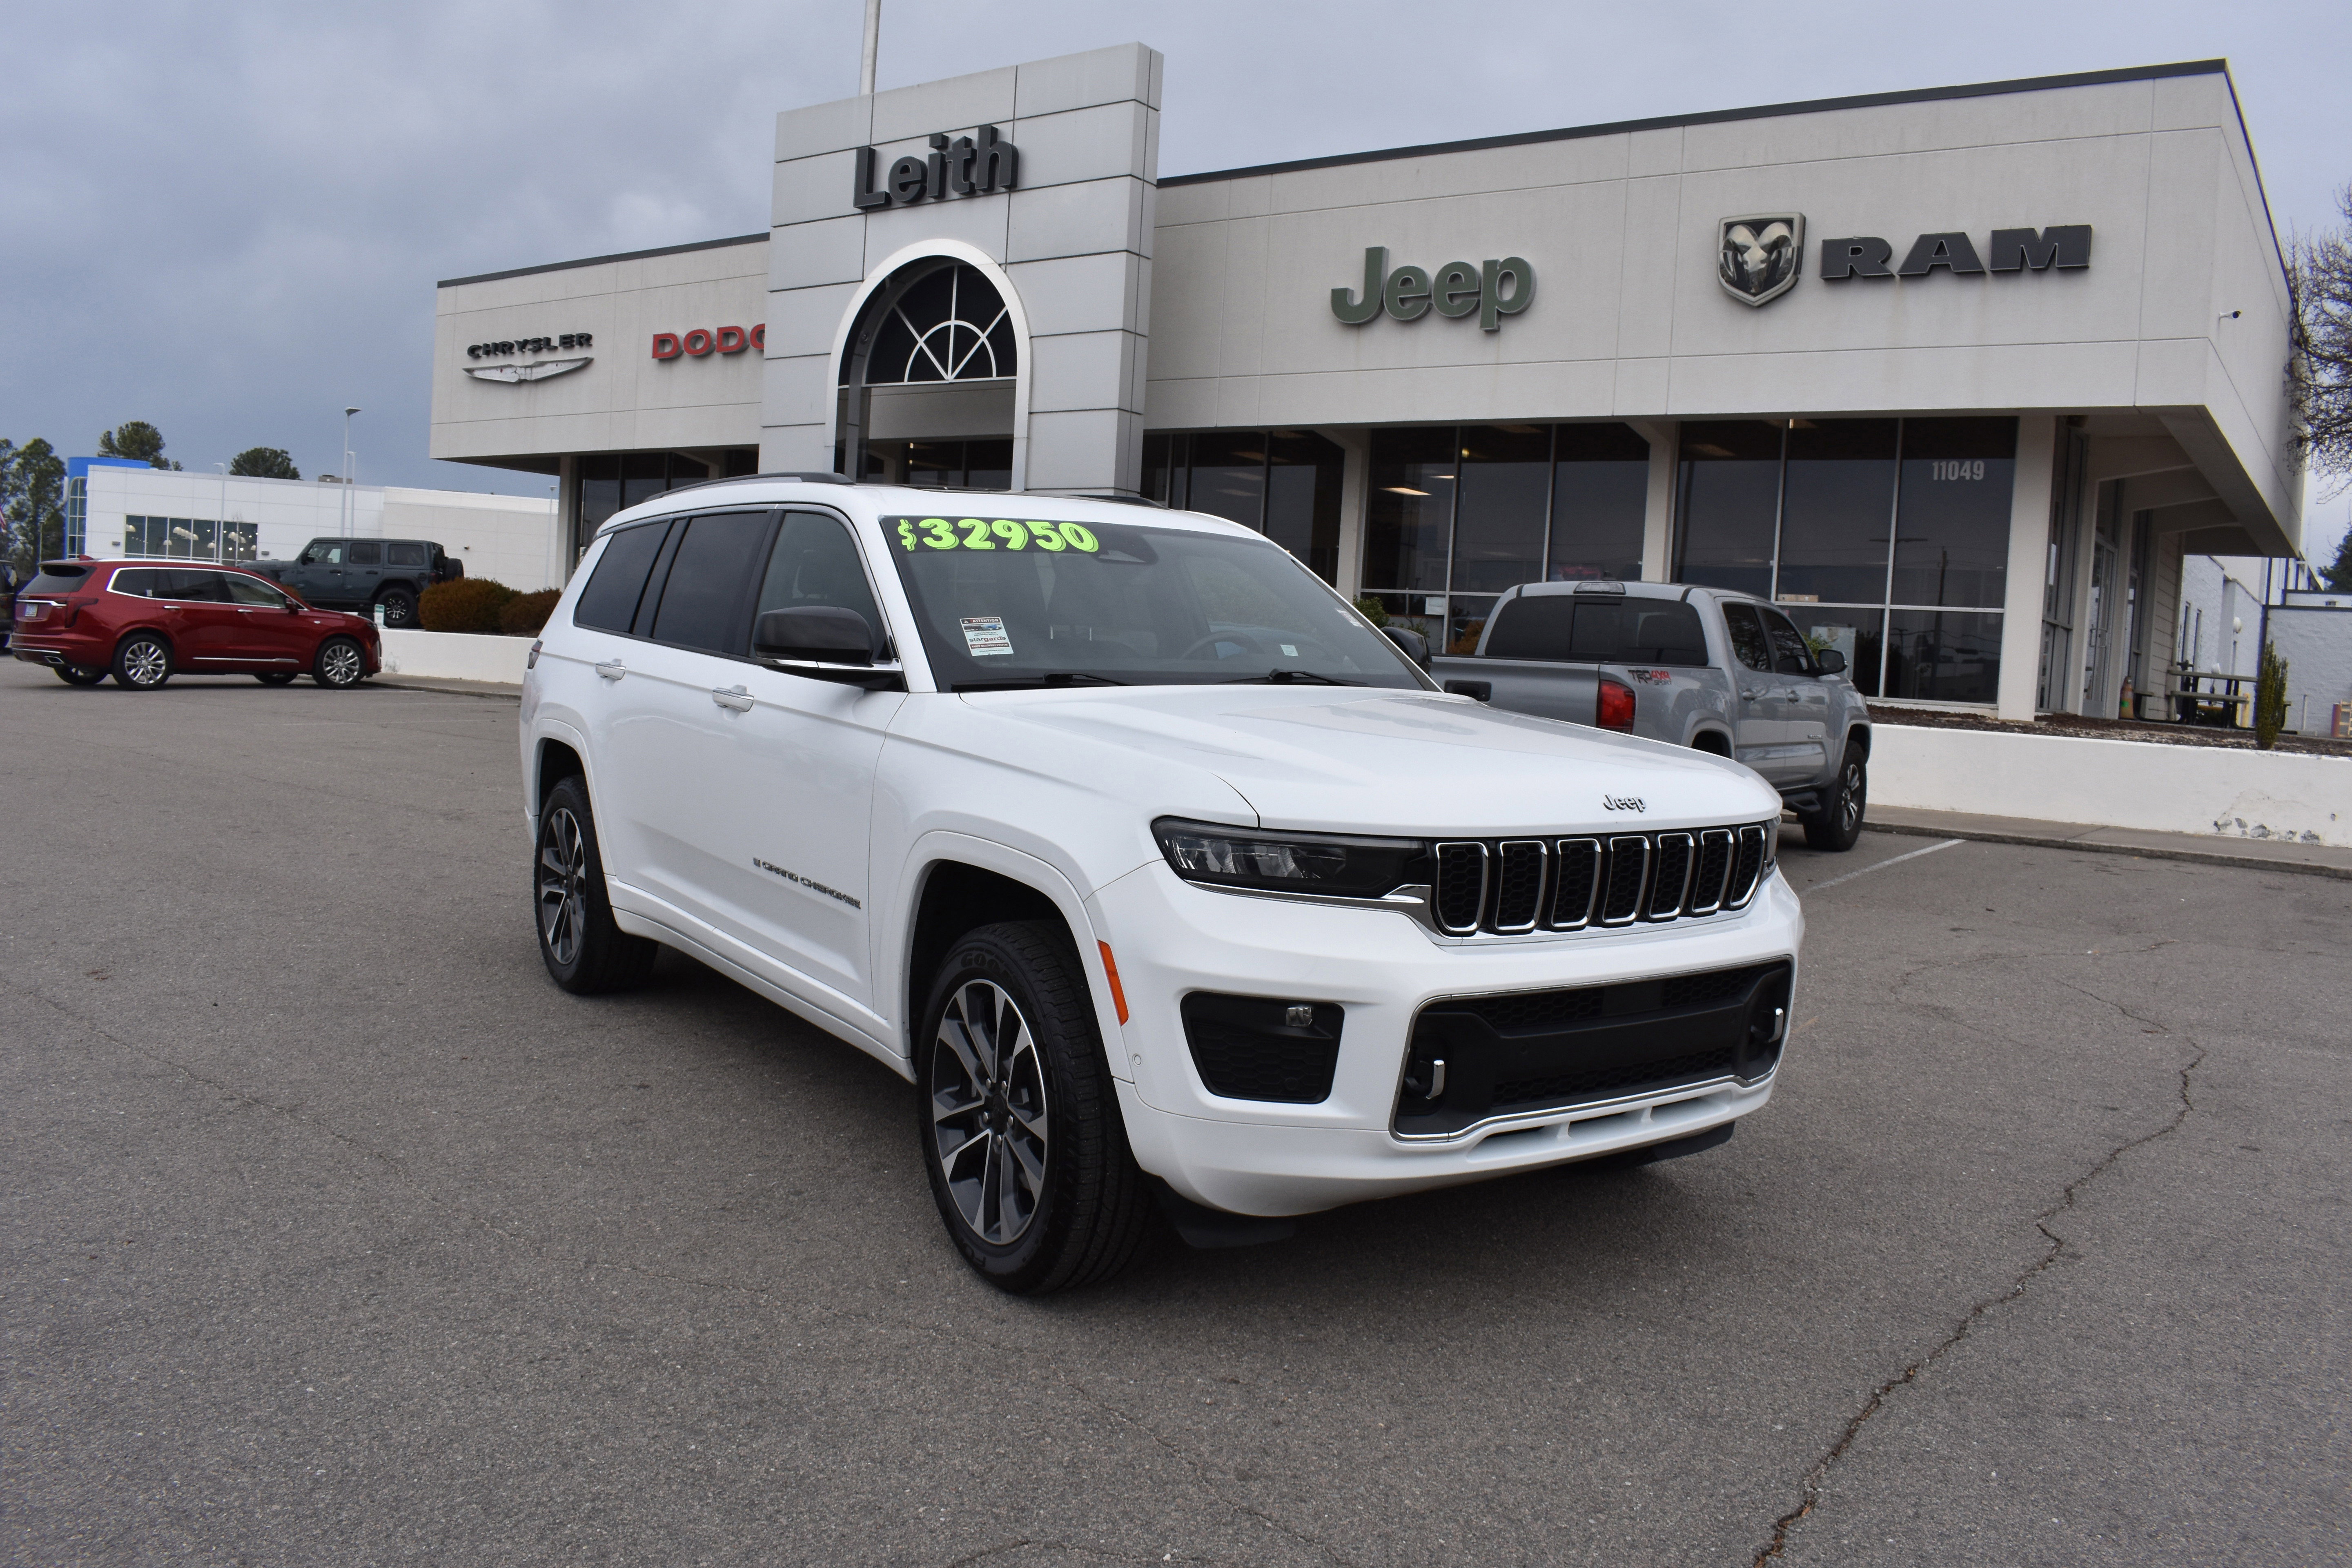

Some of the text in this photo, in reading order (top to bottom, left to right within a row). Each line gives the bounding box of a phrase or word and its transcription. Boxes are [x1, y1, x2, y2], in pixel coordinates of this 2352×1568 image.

[853, 125, 1019, 209] Leith
[1820, 224, 2092, 280] RAM
[1331, 246, 1537, 332] Jeep
[467, 332, 592, 358] CHRYSLER
[1932, 460, 1984, 481] 11049
[898, 518, 1099, 552] $32950
[1628, 670, 1653, 684] TRD
[1603, 793, 1646, 813] Jeep
[762, 861, 861, 909] GRAND CHEROKEE
